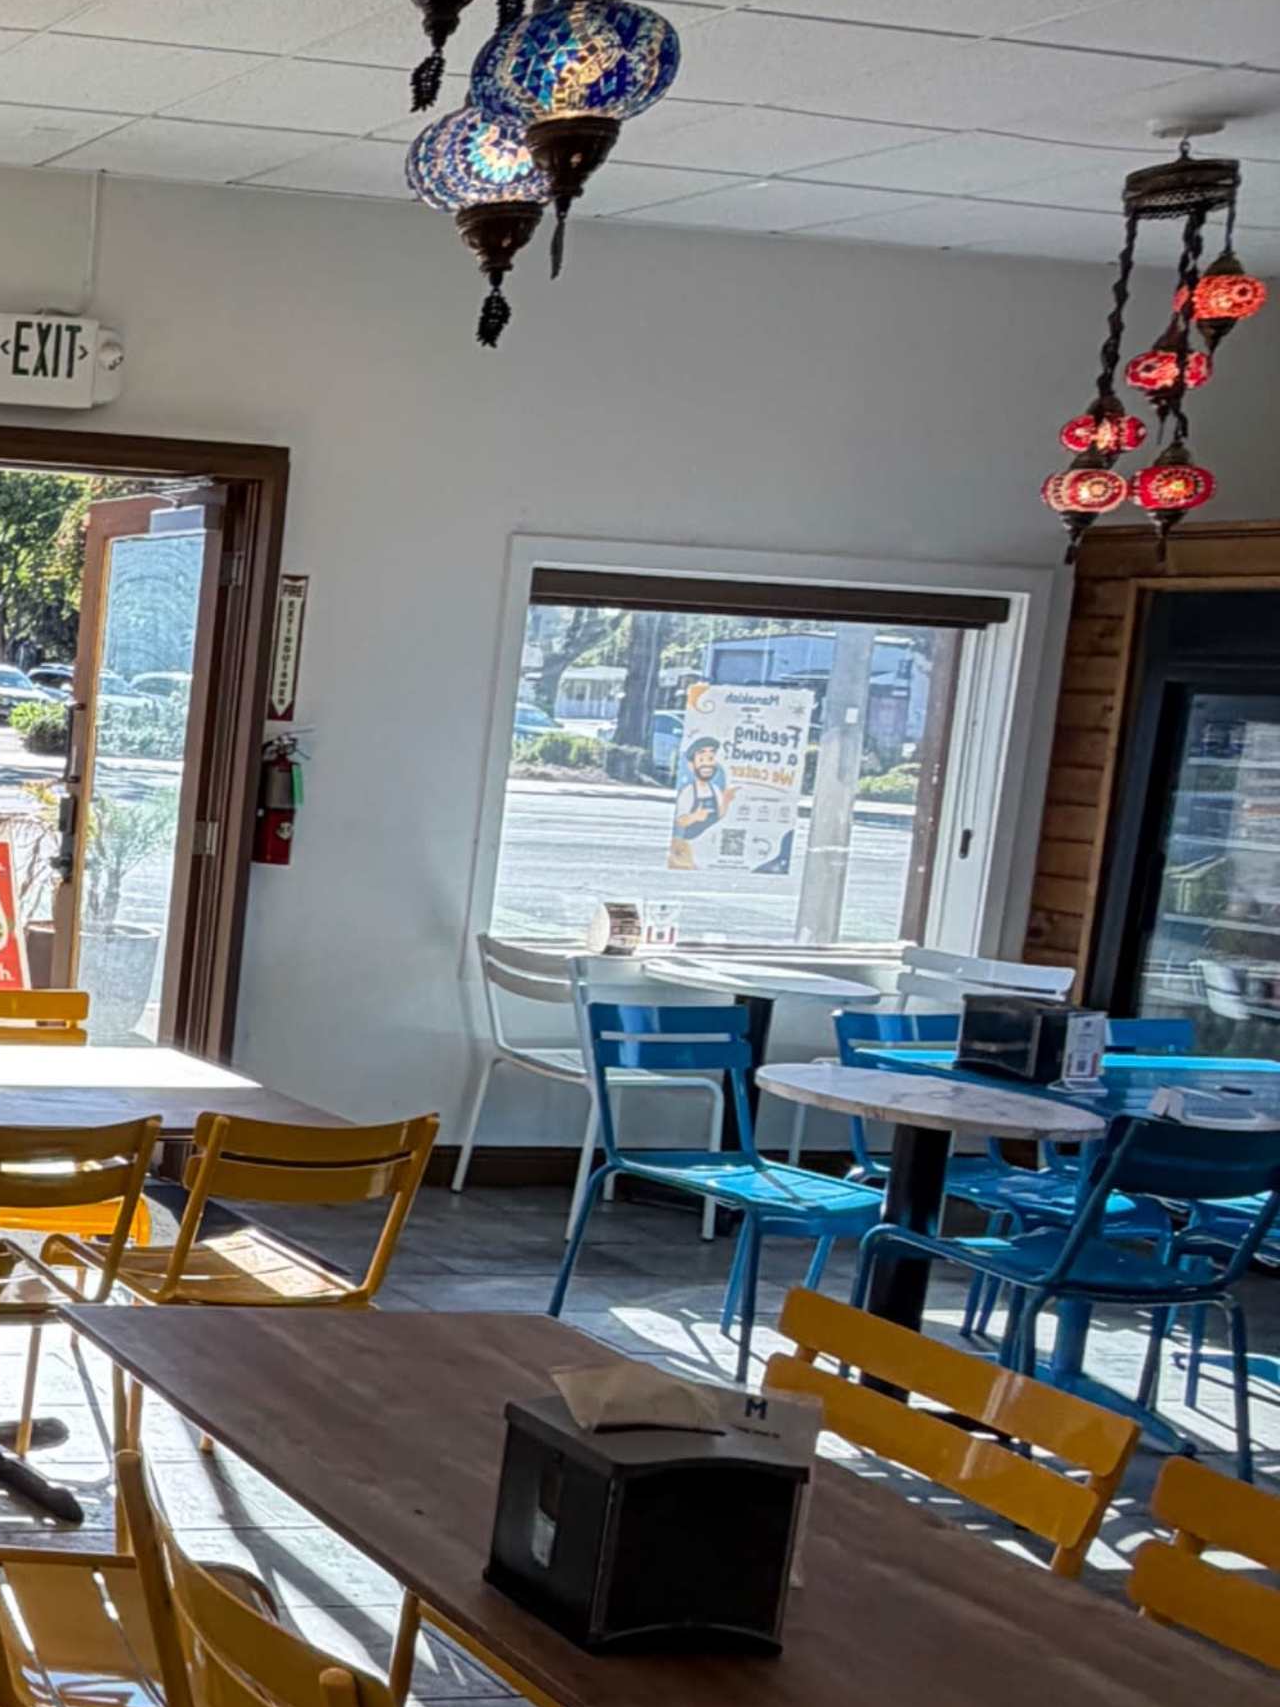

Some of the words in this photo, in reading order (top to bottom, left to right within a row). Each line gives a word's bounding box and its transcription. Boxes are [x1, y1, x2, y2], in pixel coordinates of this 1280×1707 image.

[12, 320, 83, 379] EXIT
[282, 583, 304, 598] FIRE
[276, 599, 296, 706] EXTINGUISHER
